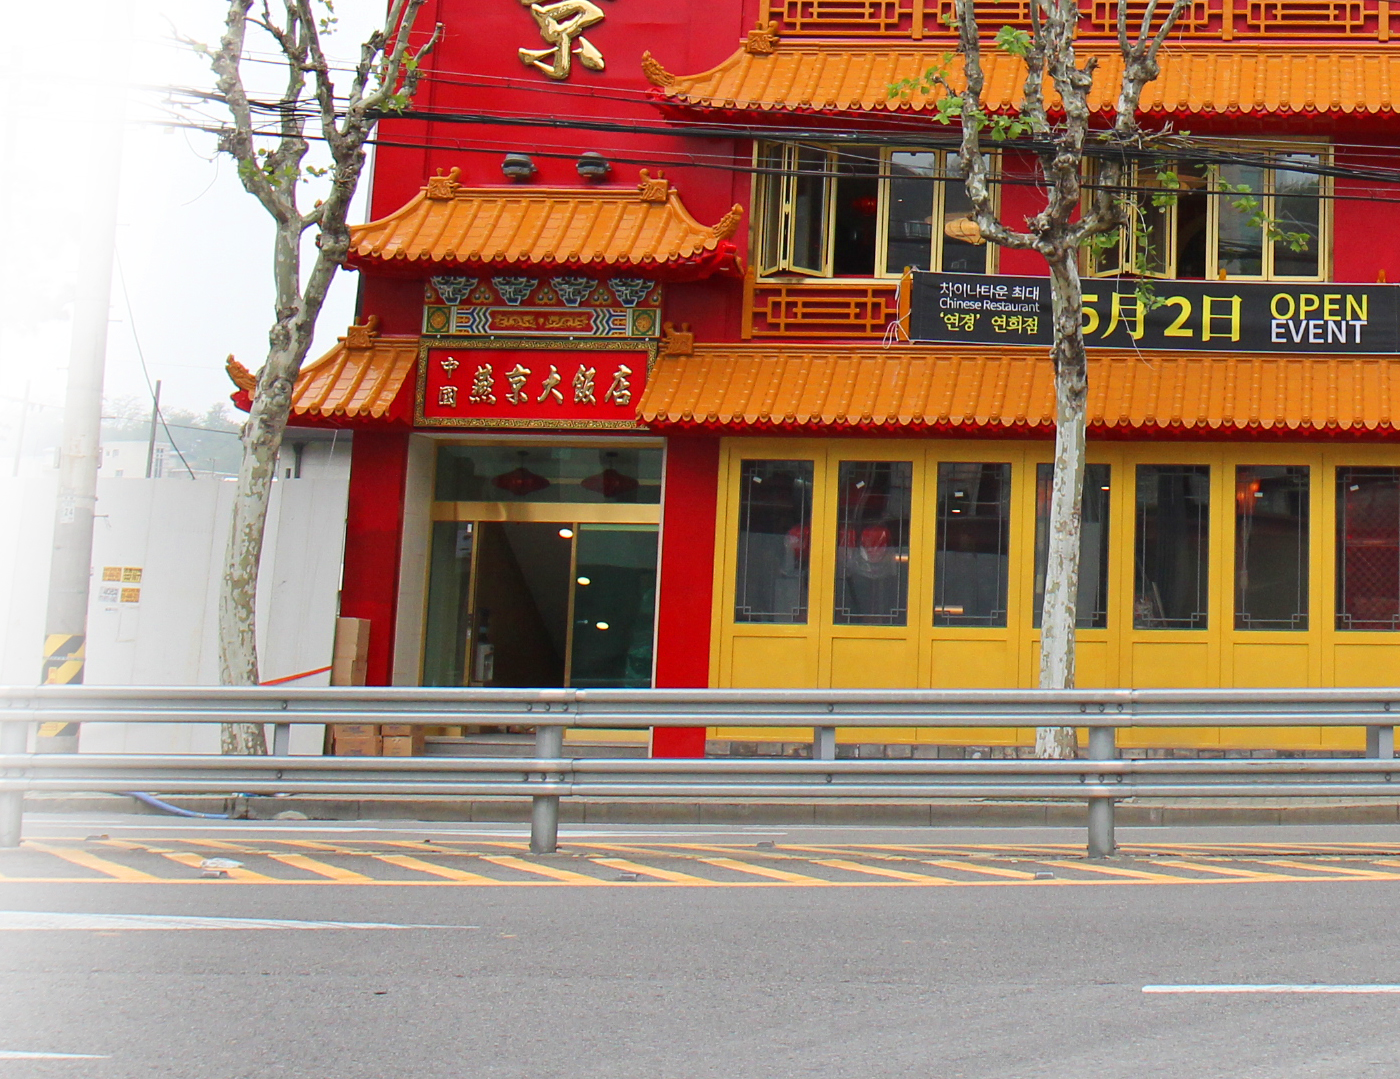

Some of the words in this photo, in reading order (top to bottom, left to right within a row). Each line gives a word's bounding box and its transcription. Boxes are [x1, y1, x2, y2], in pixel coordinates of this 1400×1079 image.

[939, 281, 1009, 300] 차이나타운
[1011, 285, 1041, 301] 최대
[939, 297, 982, 310] Chinese
[983, 299, 1041, 313] Restaurant
[1270, 292, 1369, 321] OPEN
[991, 314, 1039, 335] 연희점
[1270, 319, 1368, 344] EVENT
[437, 356, 461, 409] 中國
[468, 362, 634, 407] 燕京大飯店
